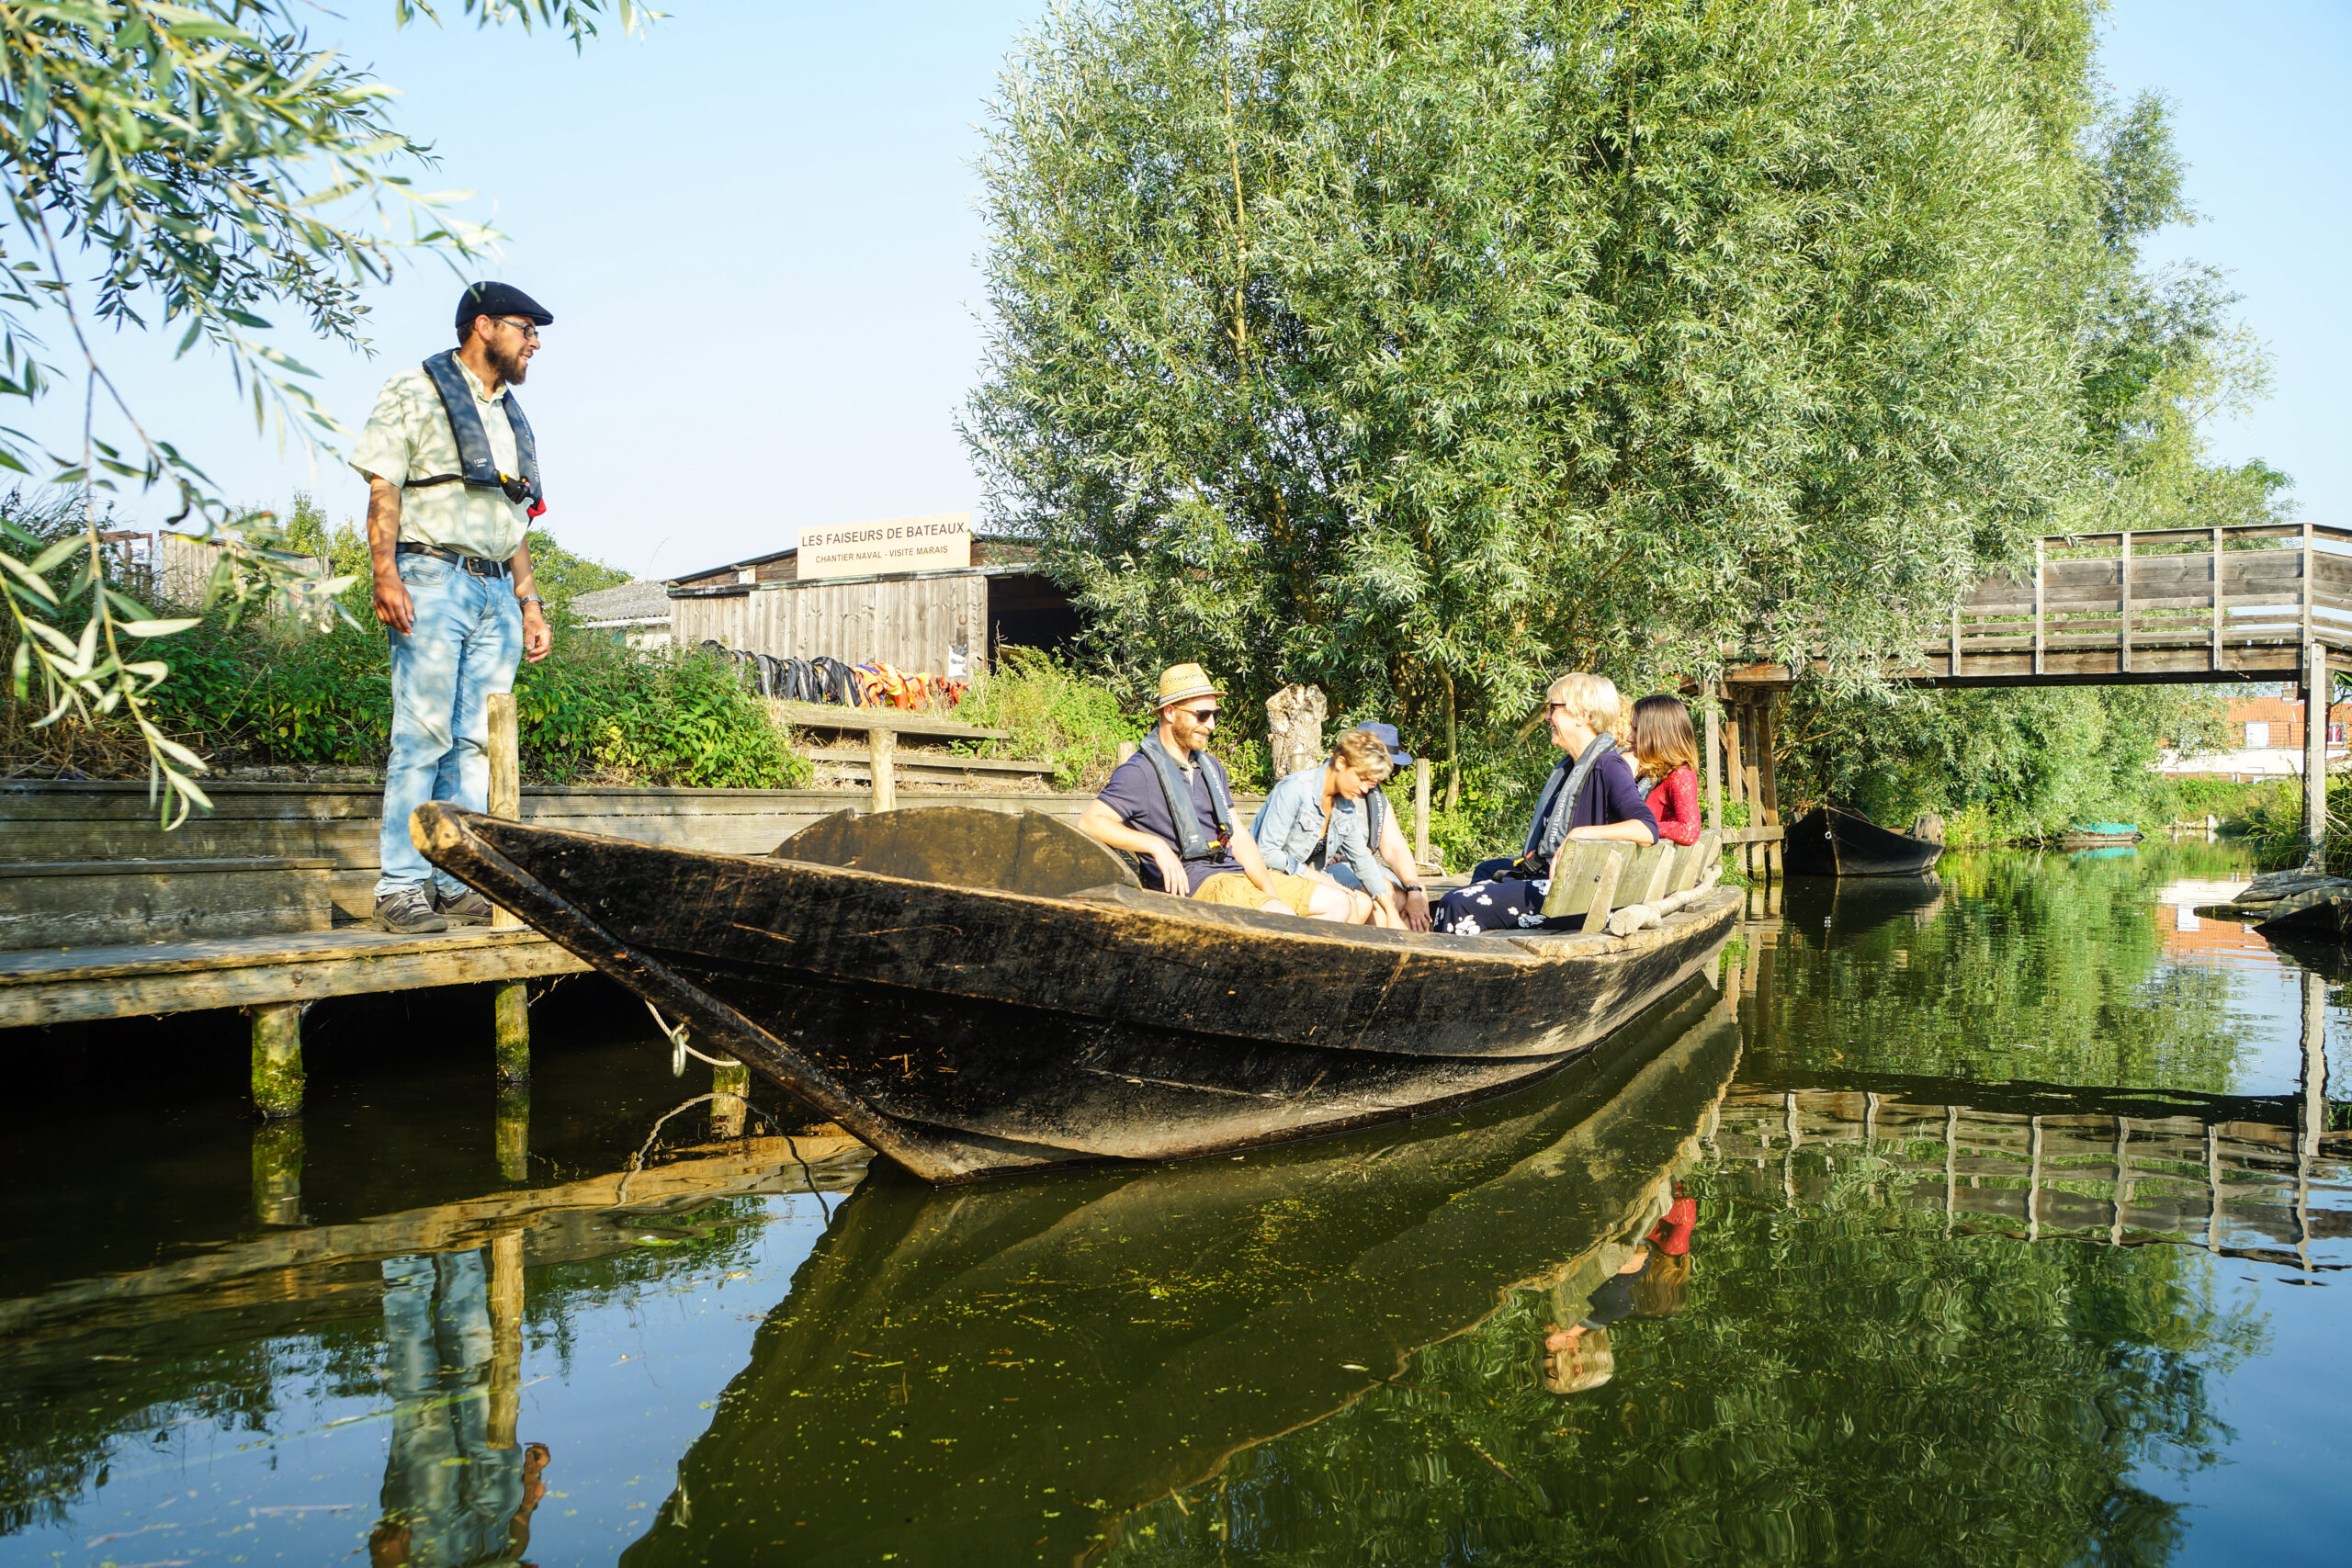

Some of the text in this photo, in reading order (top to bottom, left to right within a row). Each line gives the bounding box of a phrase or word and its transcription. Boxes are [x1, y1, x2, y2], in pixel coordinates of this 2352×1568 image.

[802, 522, 965, 547] LES FAISEURS DE BATEAUX
[815, 553, 854, 563] CHANTIER
[856, 551, 882, 560] NAVAL
[889, 548, 914, 558] VISITE
[916, 546, 948, 555] MARAIS
